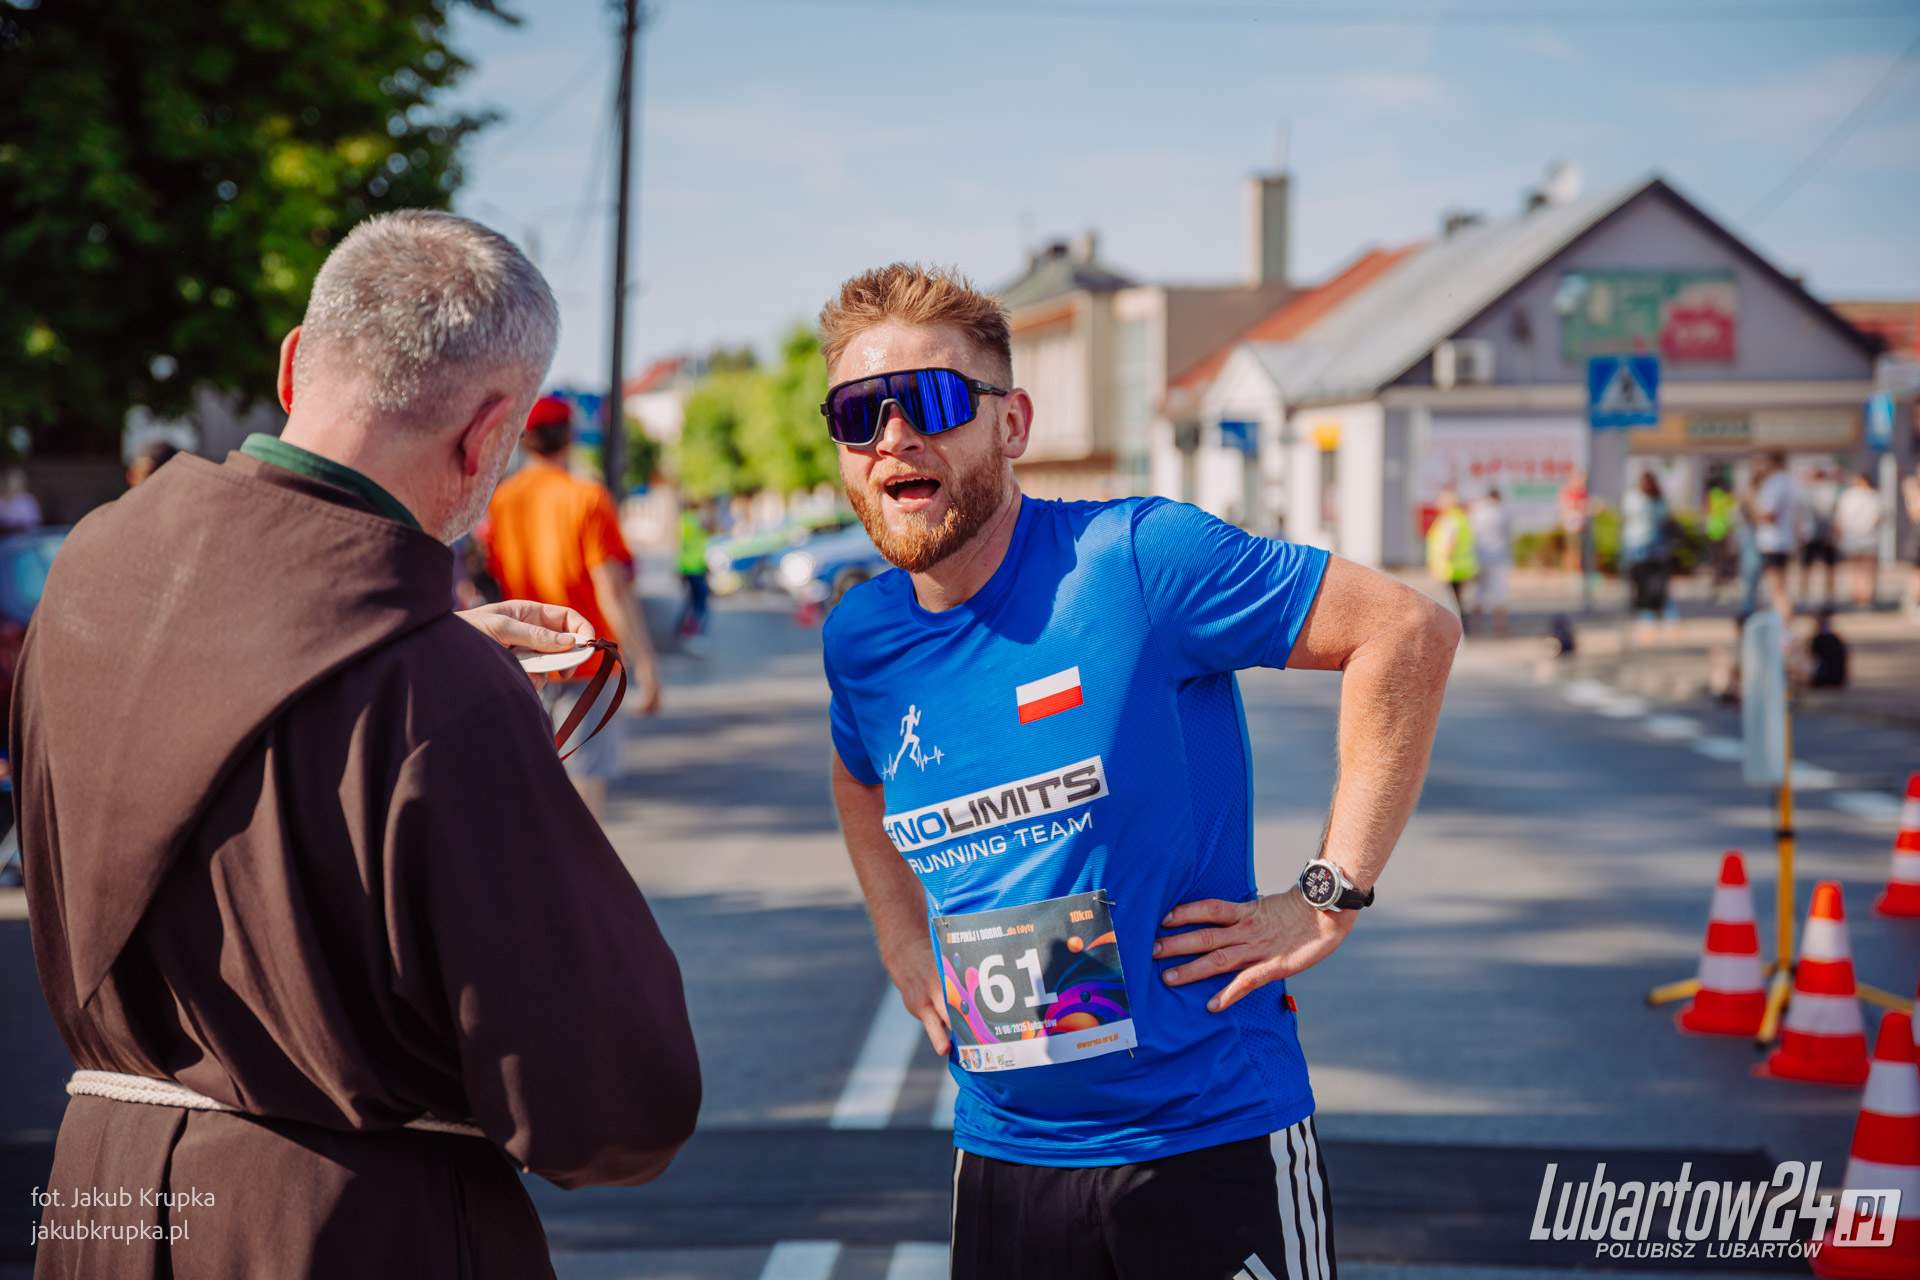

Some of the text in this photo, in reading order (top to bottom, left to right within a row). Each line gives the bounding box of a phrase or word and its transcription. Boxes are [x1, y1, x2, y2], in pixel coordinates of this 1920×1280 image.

[908, 812, 1093, 875] RUNNING TEAM
[978, 948, 1059, 1014] 61
